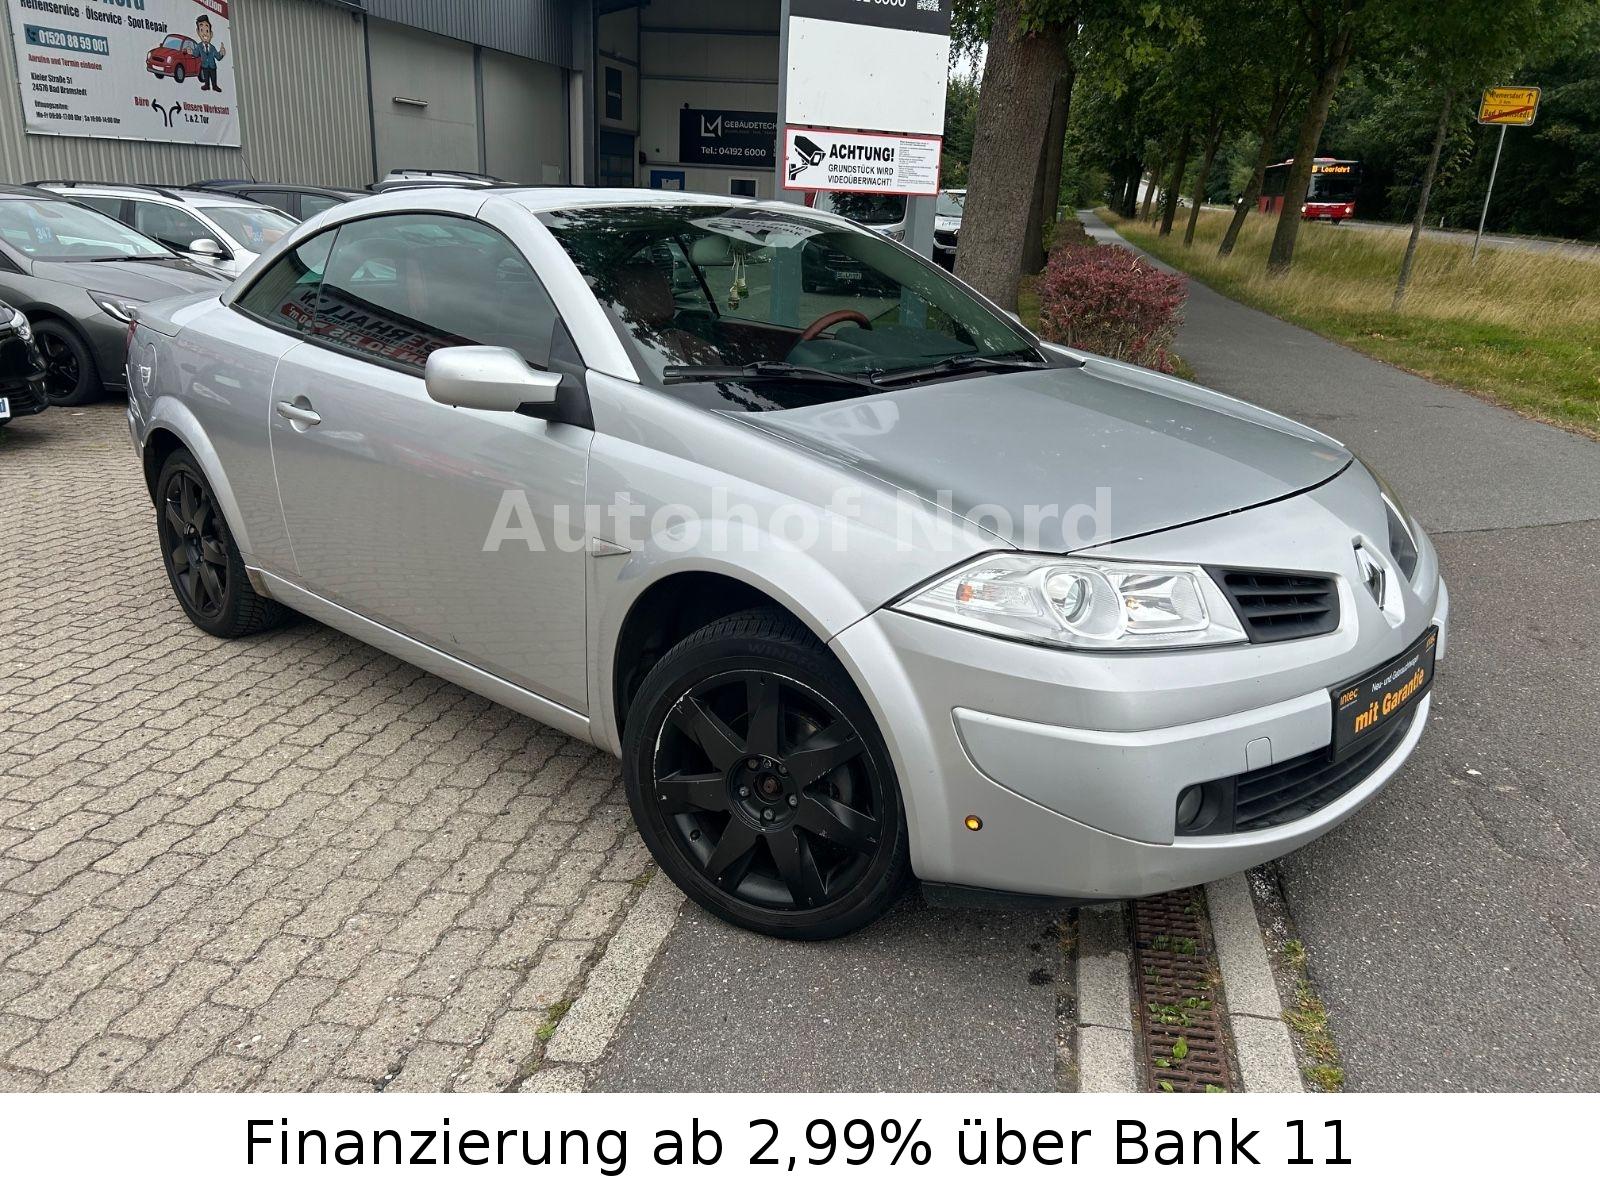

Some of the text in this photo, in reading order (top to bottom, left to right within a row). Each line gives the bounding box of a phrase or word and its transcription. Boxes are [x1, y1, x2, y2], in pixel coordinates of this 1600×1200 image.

[85, 5, 122, 25] Ölservice
[128, 15, 144, 29] Spot
[145, 19, 168, 33] Repair
[38, 29, 108, 52] 01520 88 59 001
[30, 72, 47, 82] Kieler
[48, 74, 66, 84] Straße
[49, 85, 60, 94] Bad
[60, 86, 87, 96] Bramstedt
[134, 96, 150, 107] Büro
[183, 102, 230, 115] Unsere Werkstatt
[200, 115, 209, 124] Tor
[718, 147, 743, 156] 04192
[744, 148, 767, 157] 6000
[829, 144, 895, 162] ACHTUNG!
[828, 164, 894, 176] GRUNDSTÜCK WIRD
[827, 174, 892, 186] VIDEOÜBERWACHT!
[1354, 667, 1425, 734] mit Garantie
